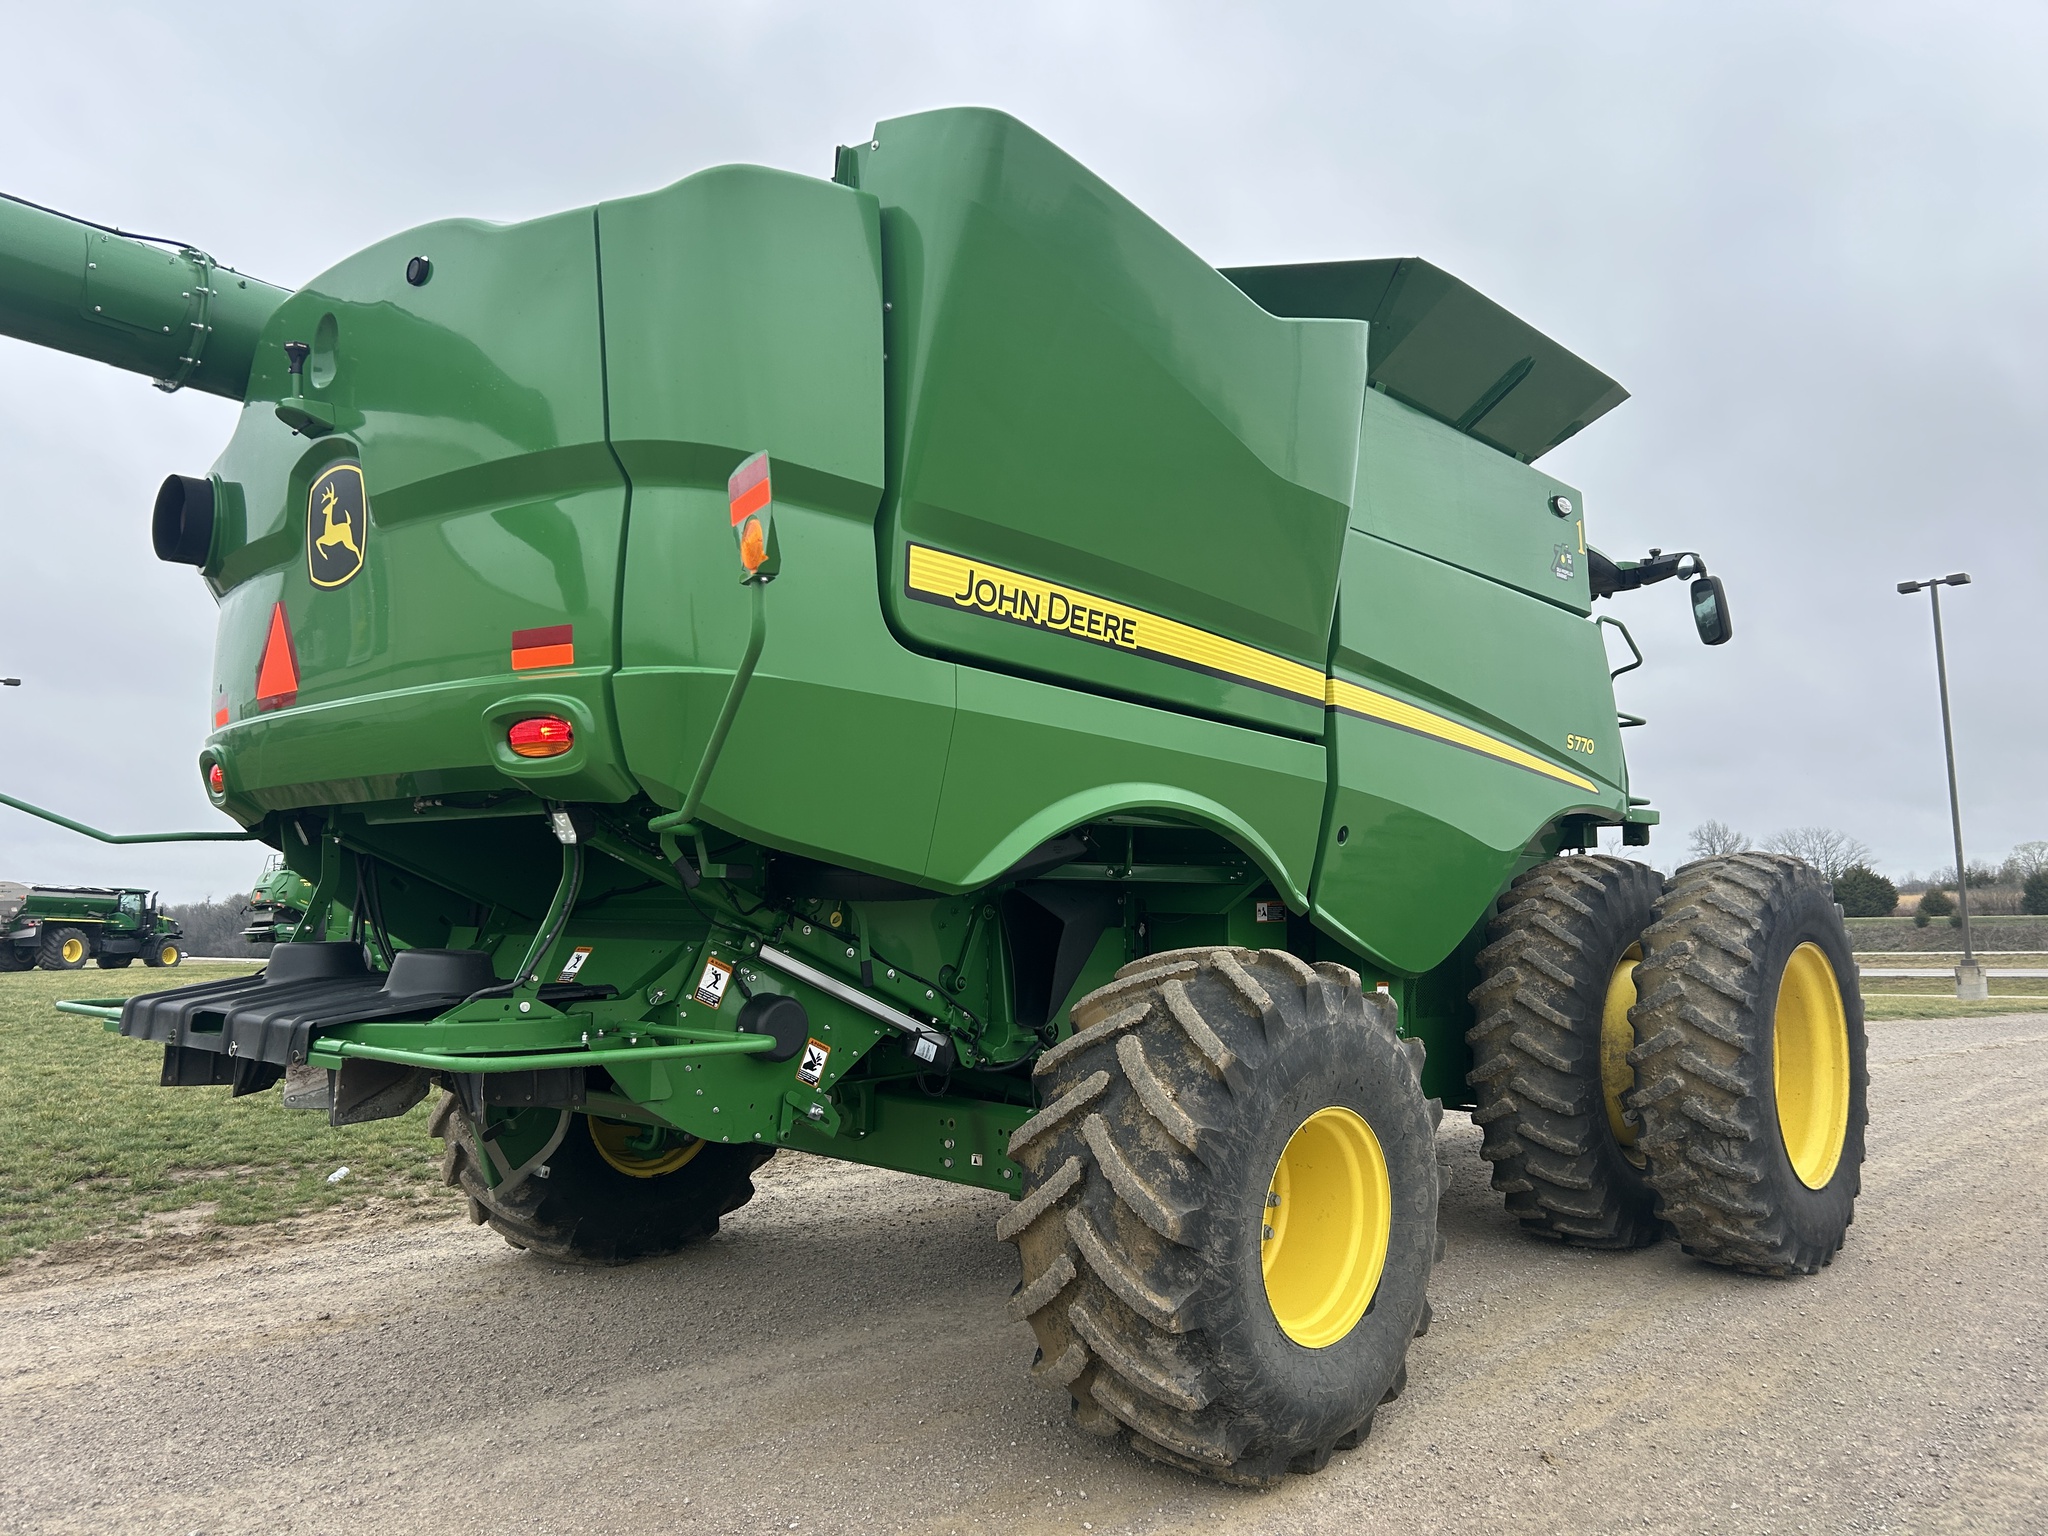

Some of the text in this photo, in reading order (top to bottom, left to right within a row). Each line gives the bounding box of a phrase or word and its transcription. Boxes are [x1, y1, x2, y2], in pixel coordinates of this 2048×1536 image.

[955, 569, 1137, 645] JOHN DEERE
[1566, 733, 1595, 755] S770
